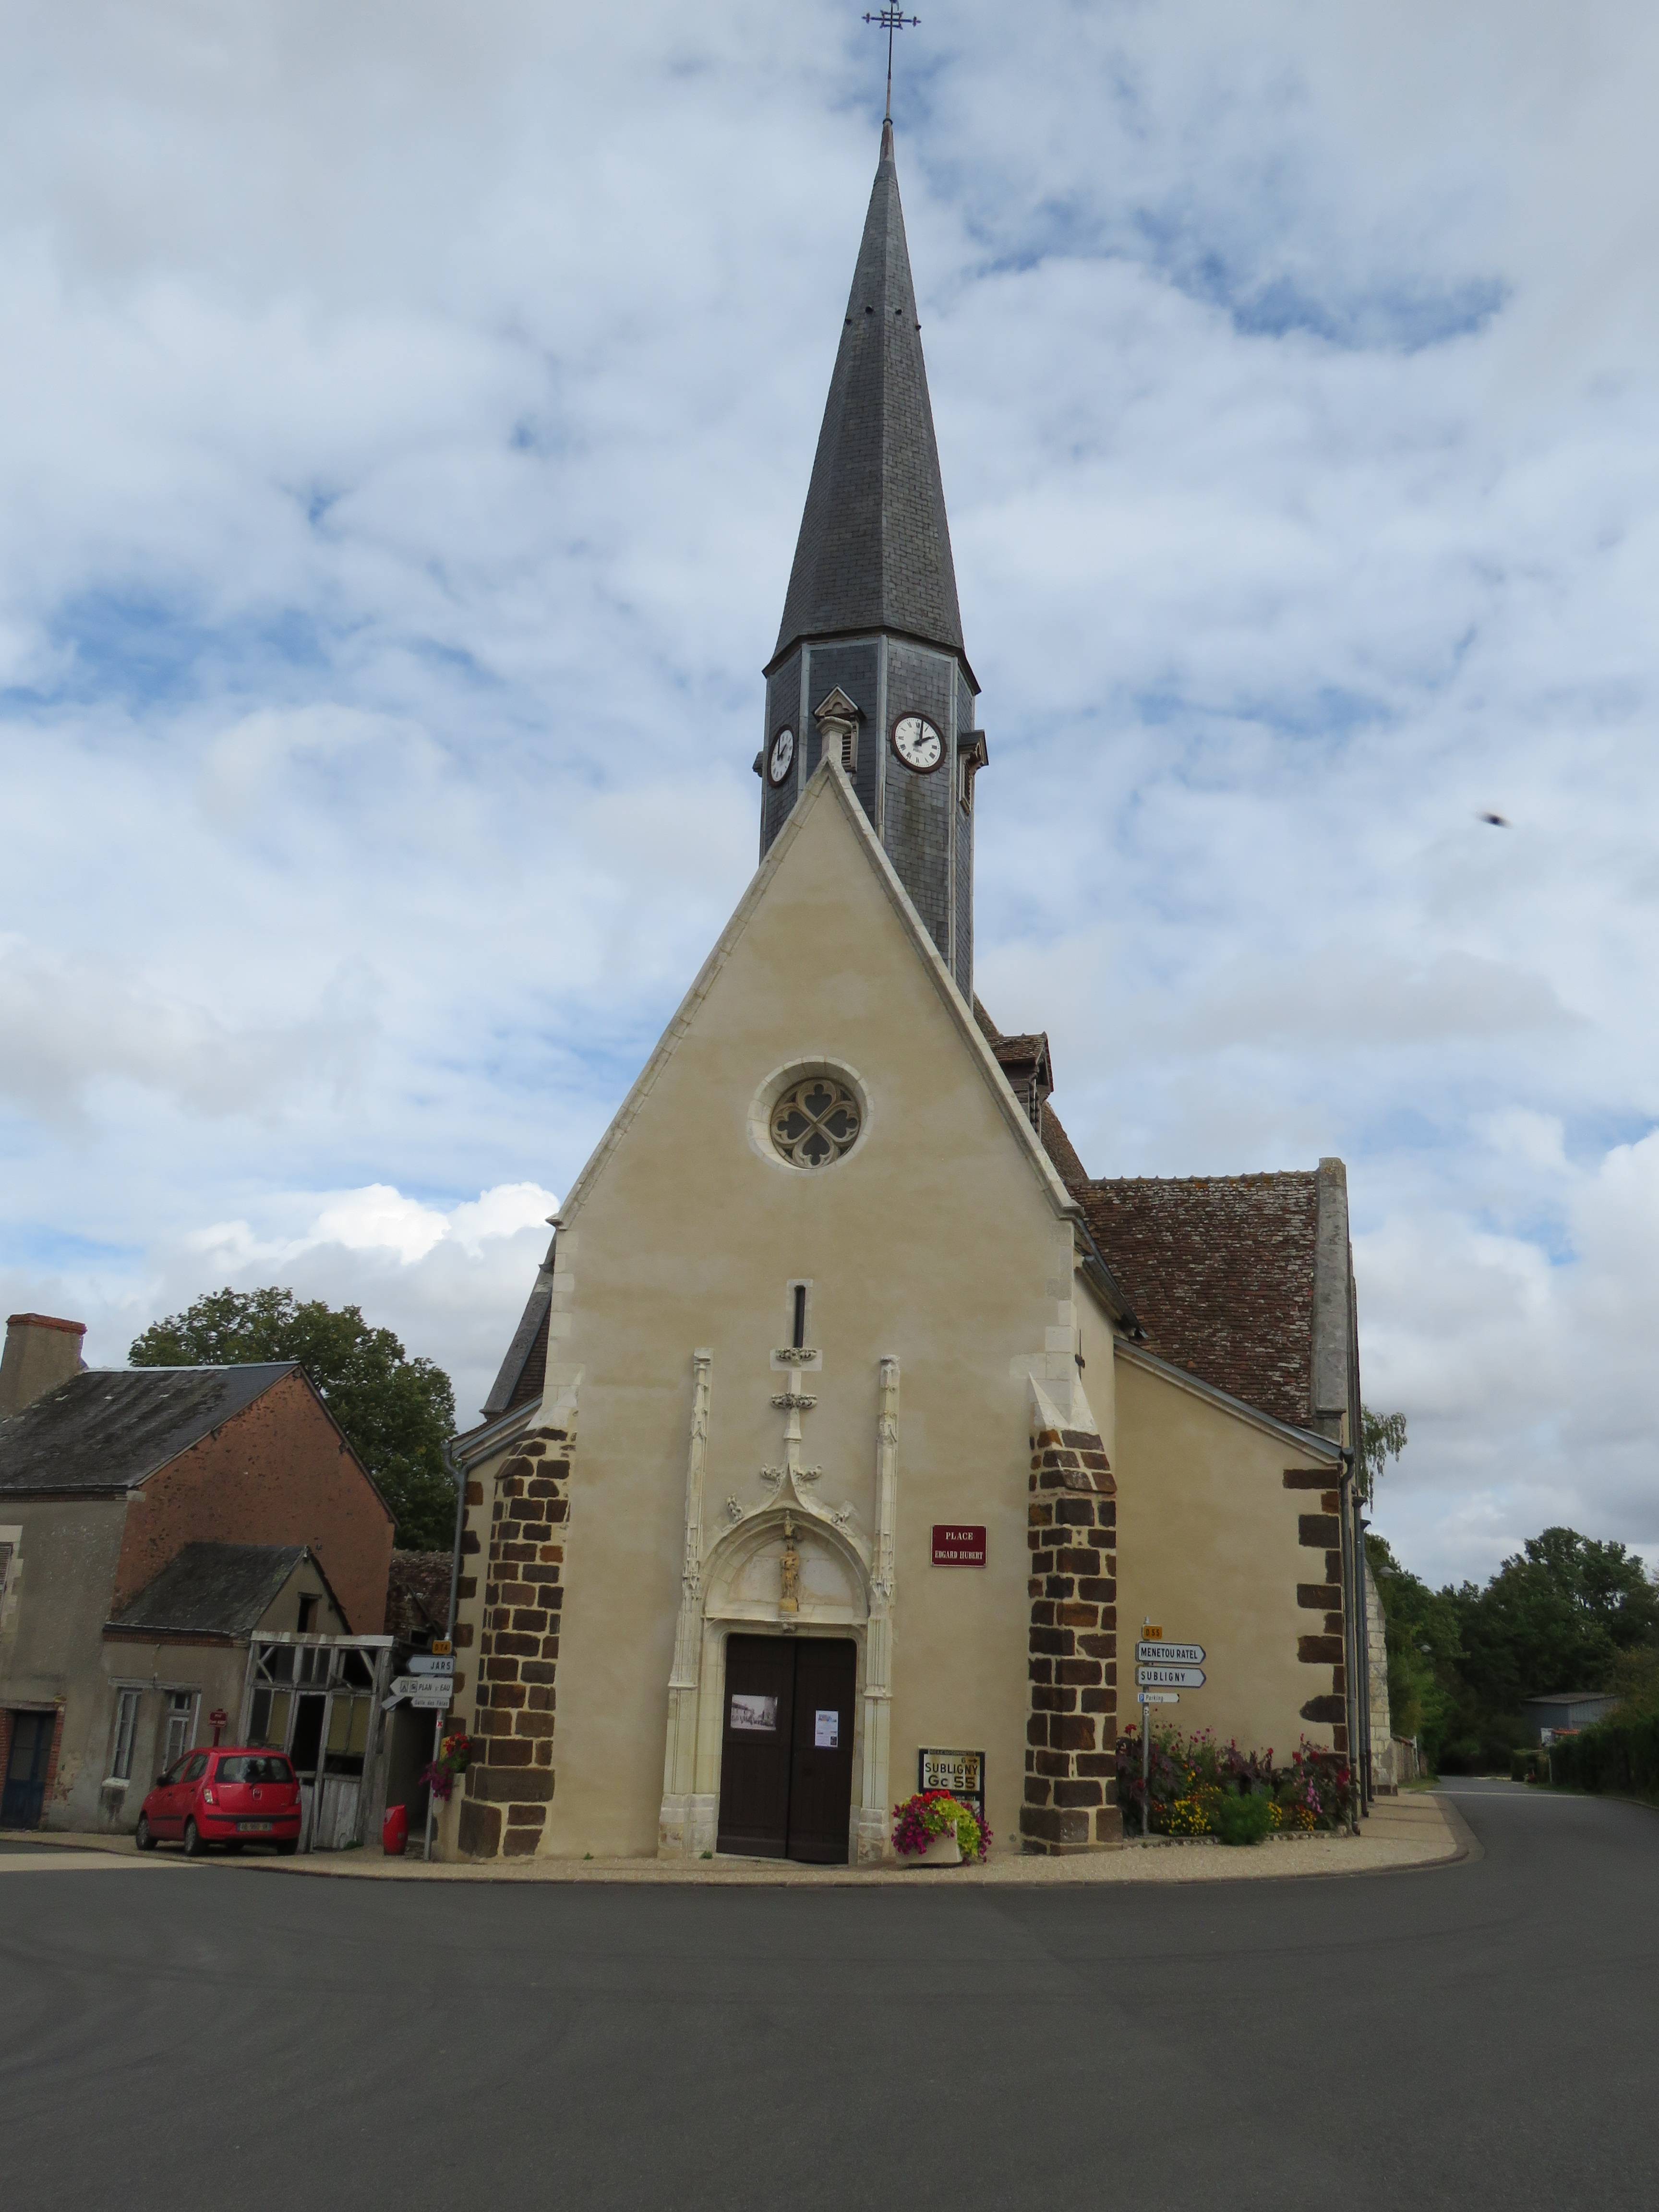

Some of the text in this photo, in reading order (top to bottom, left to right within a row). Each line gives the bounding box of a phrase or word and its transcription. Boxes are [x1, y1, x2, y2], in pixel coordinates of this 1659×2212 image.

[945, 1532, 974, 1540] PLACE
[935, 1550, 983, 1560] EDGARD HUBERT
[1141, 1647, 1198, 1659] MENETOU RATEL
[431, 1661, 451, 1670] JARS
[1141, 1671, 1186, 1682] SUBLIGNY
[1145, 1695, 1164, 1703] Parking
[925, 1762, 978, 1775] SUBLIGNY
[954, 1776, 975, 1789] 55
